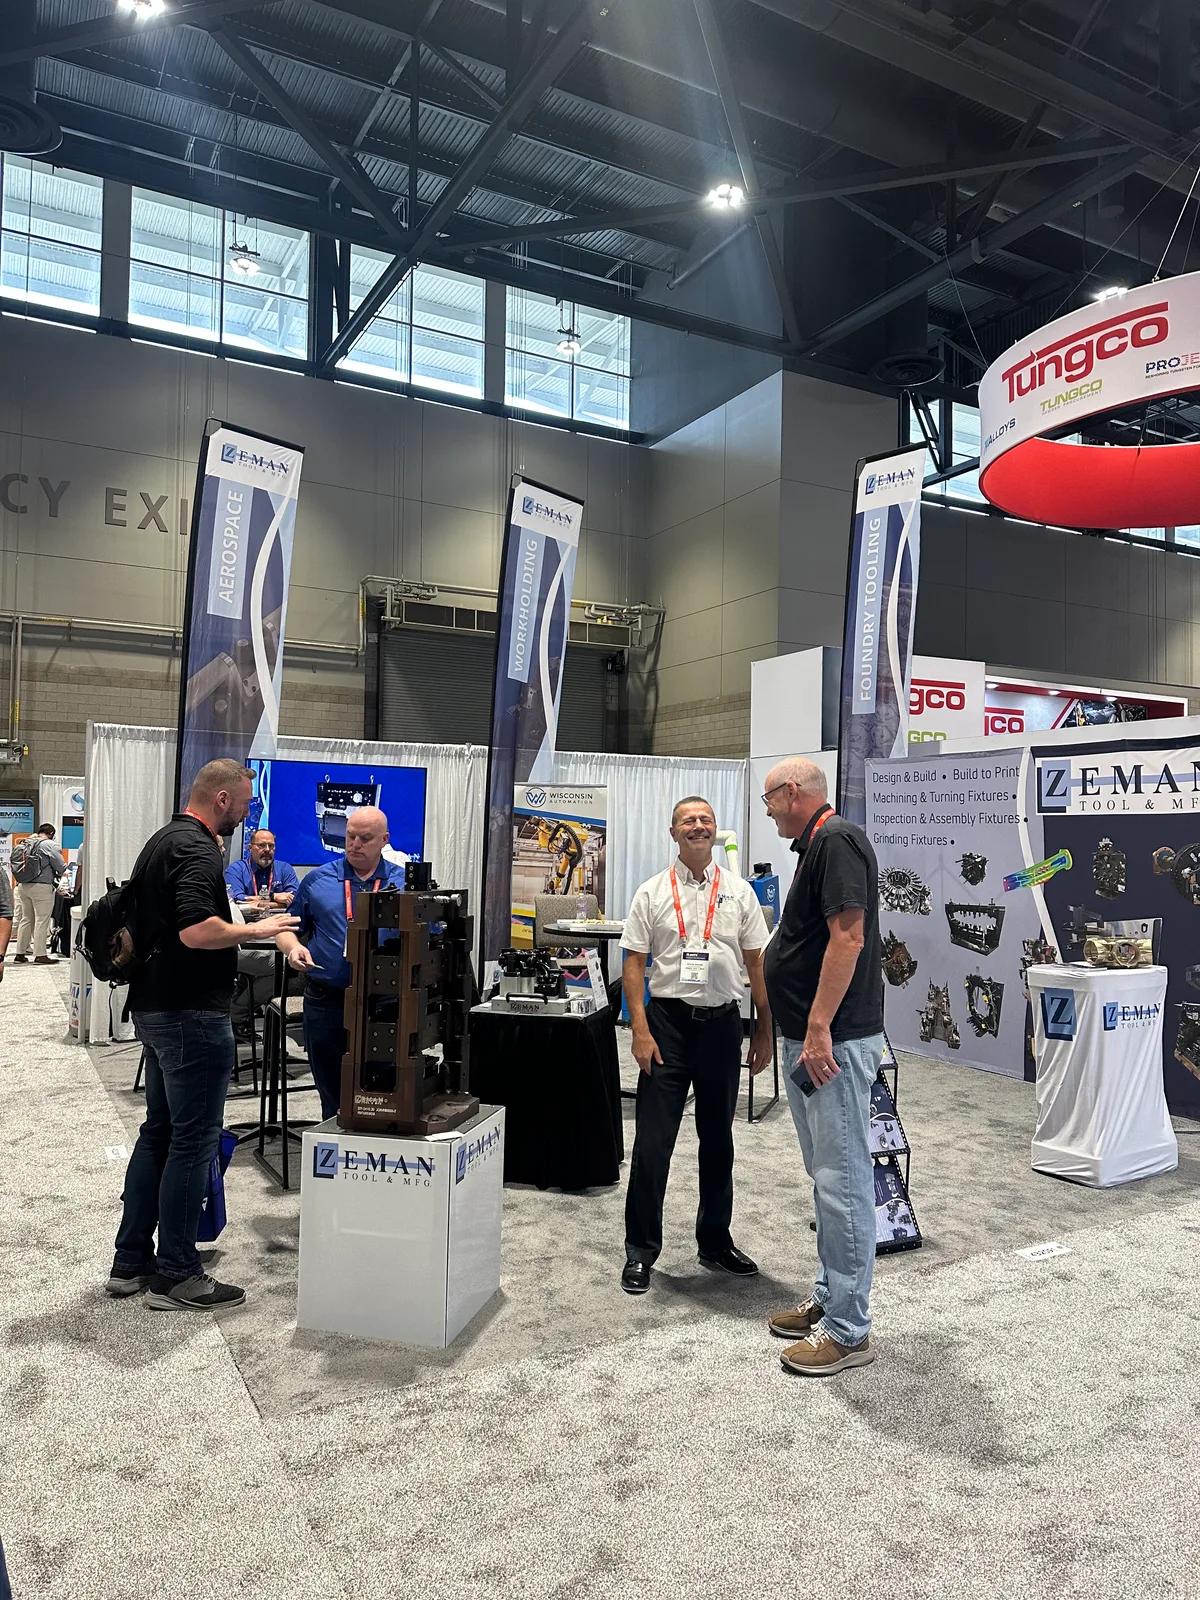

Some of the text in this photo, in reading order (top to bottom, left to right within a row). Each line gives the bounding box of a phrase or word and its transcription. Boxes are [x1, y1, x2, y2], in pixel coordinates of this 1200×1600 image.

[1001, 301, 1169, 404] Tungco
[1040, 379, 1103, 412] TUNGCO
[225, 446, 289, 474] ZEMAN
[238, 462, 257, 470] TOOL
[868, 467, 915, 488] ZEMAN
[525, 499, 572, 524] ZEMAN
[219, 490, 243, 604] AEROSPACE
[514, 539, 538, 672] WORKHOLDING
[860, 517, 881, 701] FOUNDRY TOOLING
[873, 766, 1020, 785] Design & Build Build to Print
[873, 790, 1009, 806] Machining & Turning Fixtures
[1080, 800, 1130, 811] TOOL
[1145, 799, 1155, 810] &
[873, 813, 1020, 826] Inspection & Assembly Fixtures
[873, 833, 948, 847] Grinding Fixtures
[1050, 996, 1073, 1025] Z
[1108, 1002, 1161, 1022] ZEMAN
[459, 1124, 500, 1171] ZEMAN
[319, 1147, 435, 1177] ZEMAN
[343, 1172, 377, 1182] TOOL
[387, 1176, 393, 1184] &
